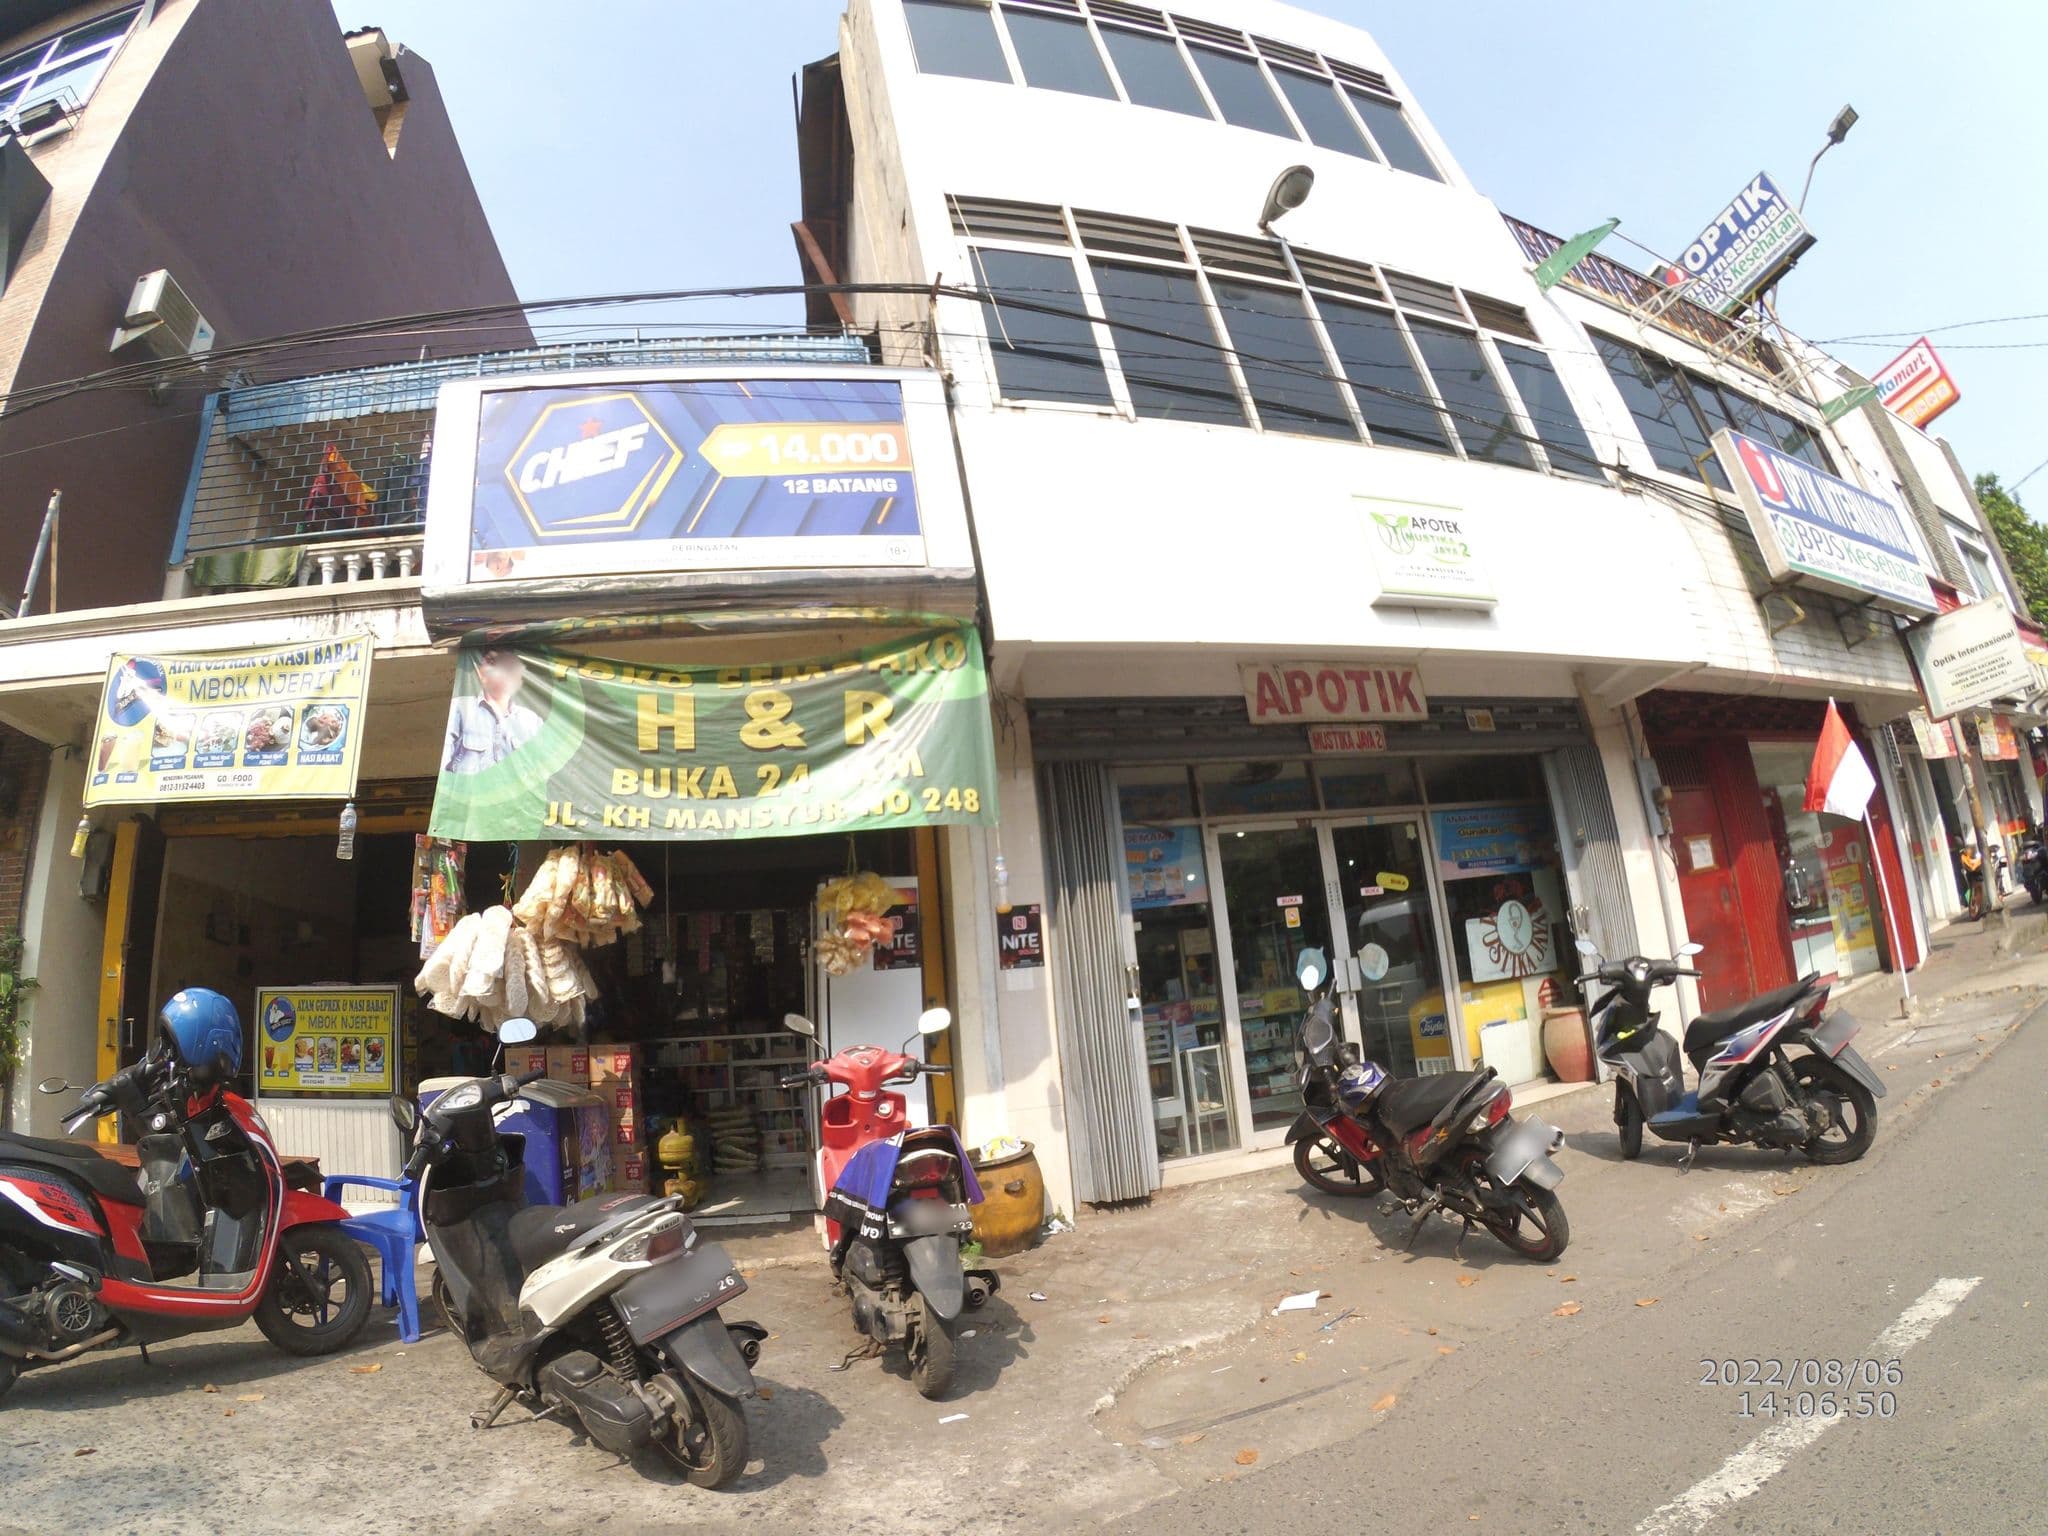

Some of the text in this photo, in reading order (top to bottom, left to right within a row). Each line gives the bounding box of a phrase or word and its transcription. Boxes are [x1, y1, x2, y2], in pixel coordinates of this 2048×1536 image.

[1684, 177, 1774, 271] OPTIK
[1730, 213, 1796, 280] Kesehatan
[519, 422, 649, 494] CHIEF
[760, 432, 898, 465] 14.000
[783, 478, 897, 494] 12 BATANG
[1412, 517, 1462, 534] APOTEK
[672, 543, 739, 553] PERINGATAN
[1459, 542, 1471, 557] 2
[1794, 521, 1845, 560] BPJS
[1844, 541, 1925, 588] Kesehatan
[276, 650, 309, 667] NASI
[313, 642, 361, 665] BABAT
[1933, 653, 1957, 669] Optik
[1958, 629, 2015, 658] Internasional
[189, 673, 248, 702] MBOK
[258, 669, 341, 697] NJERIT
[1256, 669, 1422, 717] APOTIK
[636, 689, 896, 752] H & R
[1312, 730, 1383, 750] MUSTIKA JAYA 2
[301, 753, 340, 763] NASI BABAT
[232, 774, 253, 782] FOOD
[610, 767, 739, 799] BUKA
[757, 763, 812, 797] 24
[543, 788, 980, 830] JL. KH MANSYUR NO 248
[308, 1017, 337, 1029] MBOK
[341, 1017, 380, 1030] NJERIT
[656, 1217, 681, 1232] YAMAHA
[717, 1275, 735, 1291] 26
